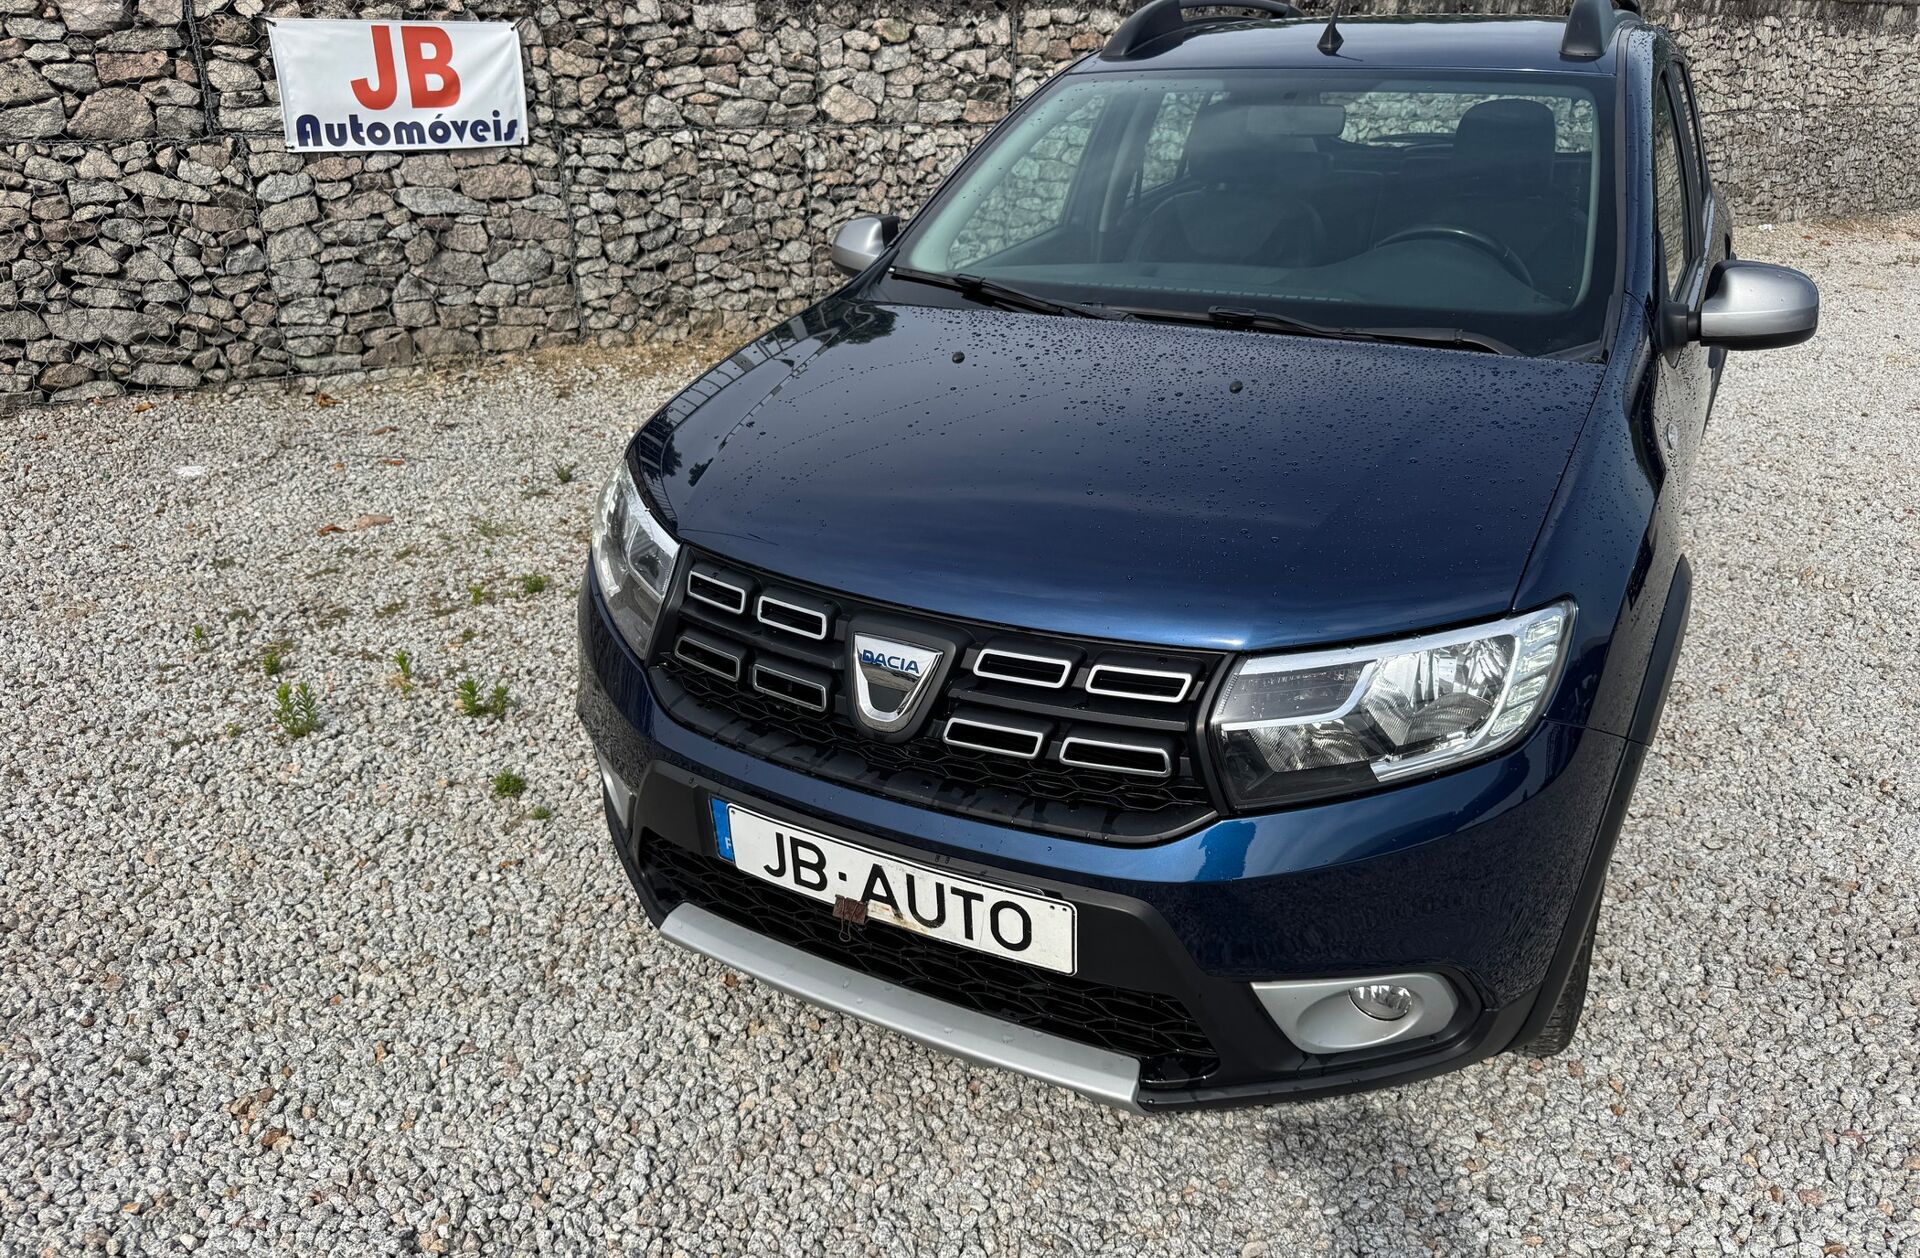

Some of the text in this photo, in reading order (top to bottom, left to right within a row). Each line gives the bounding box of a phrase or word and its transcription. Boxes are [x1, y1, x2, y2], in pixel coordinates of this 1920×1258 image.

[350, 25, 461, 110] JB
[296, 110, 518, 147] Automóveis
[862, 649, 920, 674] DACIA
